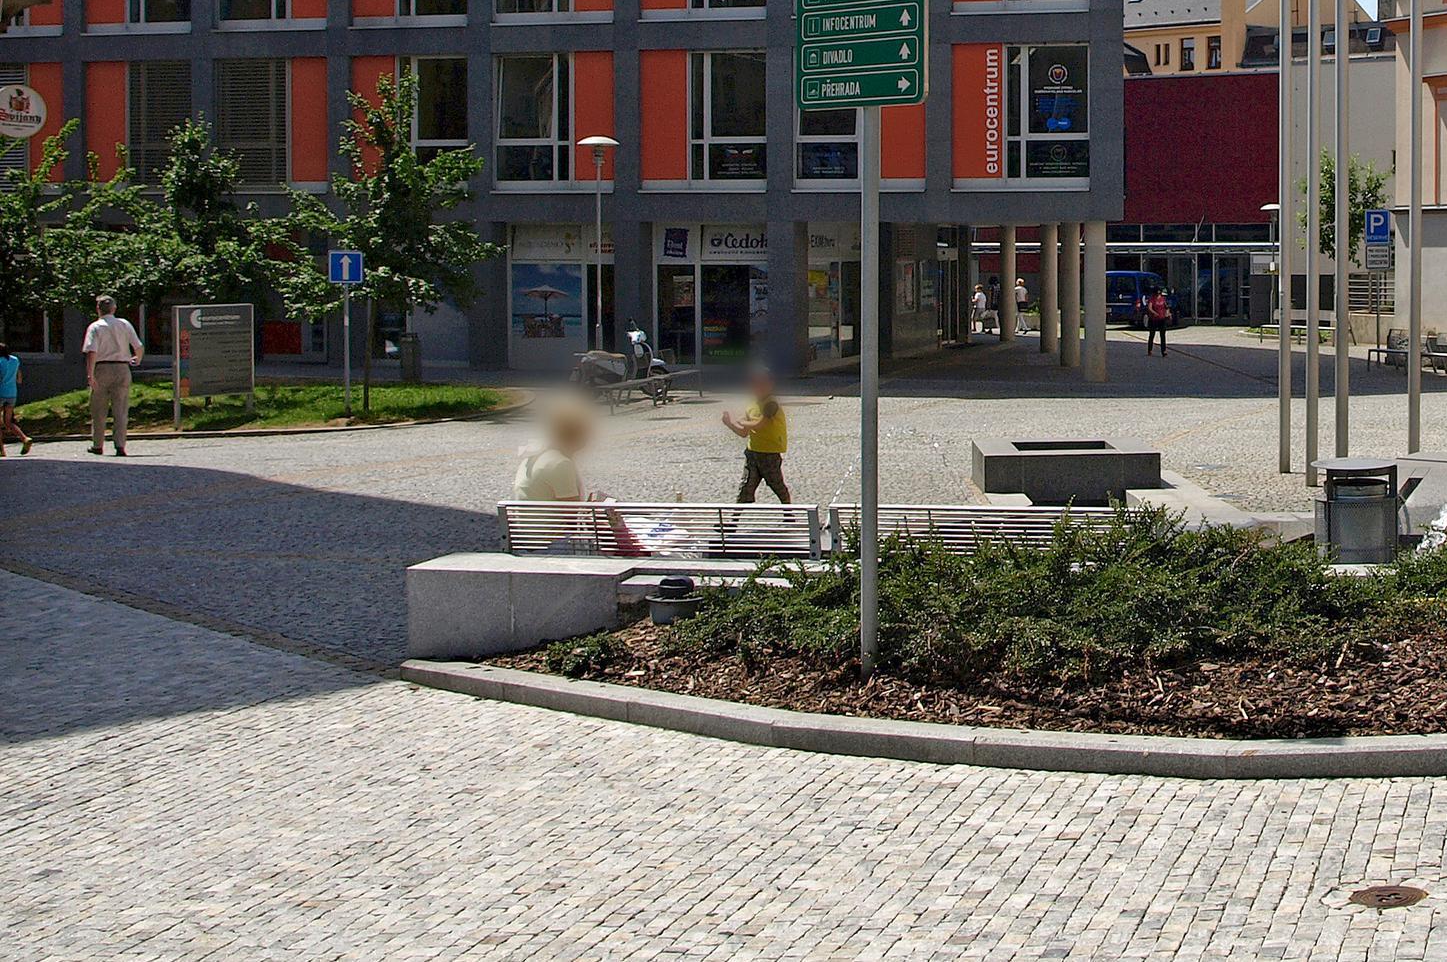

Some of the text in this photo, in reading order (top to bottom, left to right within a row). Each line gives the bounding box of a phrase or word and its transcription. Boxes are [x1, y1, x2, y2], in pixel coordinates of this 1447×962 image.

[822, 14, 876, 32] INFOCENTRUM
[822, 49, 853, 65] DIVADLO
[821, 79, 861, 98] PŘEHRADA
[984, 48, 998, 174] eurocentrum
[1370, 214, 1385, 234] P
